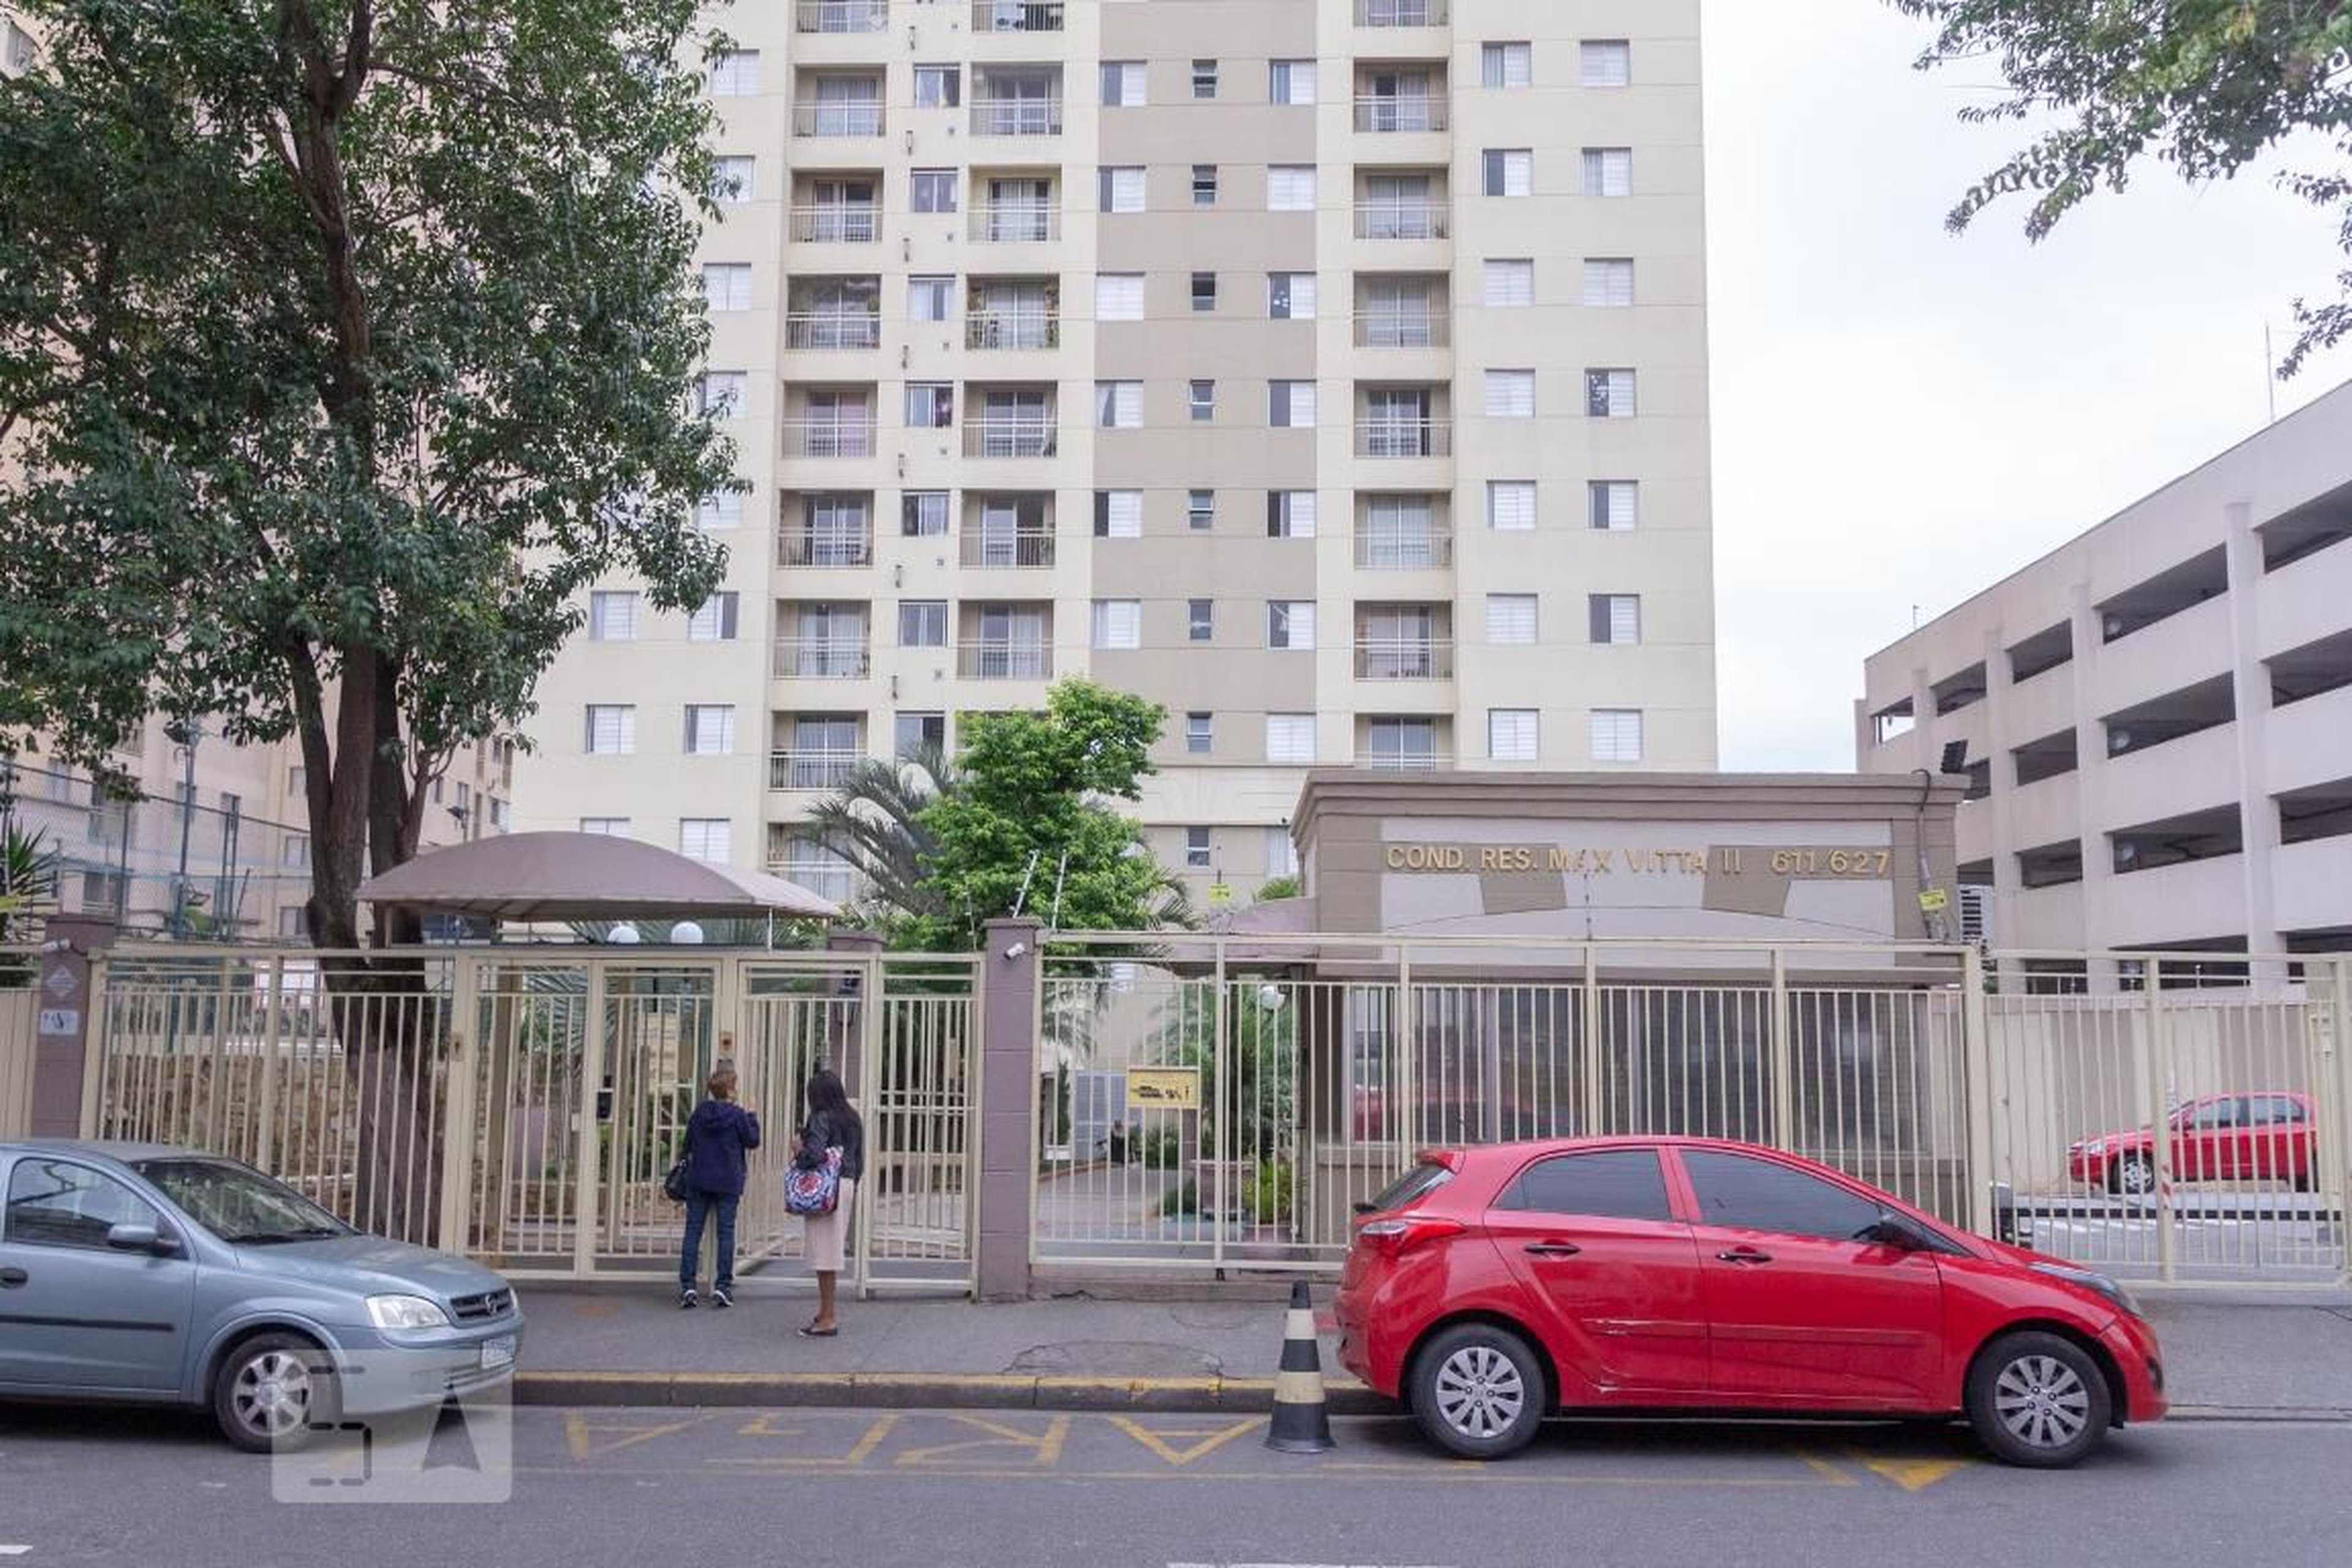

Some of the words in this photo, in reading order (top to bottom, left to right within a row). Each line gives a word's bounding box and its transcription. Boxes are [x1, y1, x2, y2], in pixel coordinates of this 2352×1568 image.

[1387, 846, 1471, 870] COND.
[1480, 847, 1538, 871] RES.
[1624, 849, 1707, 874] VITTA
